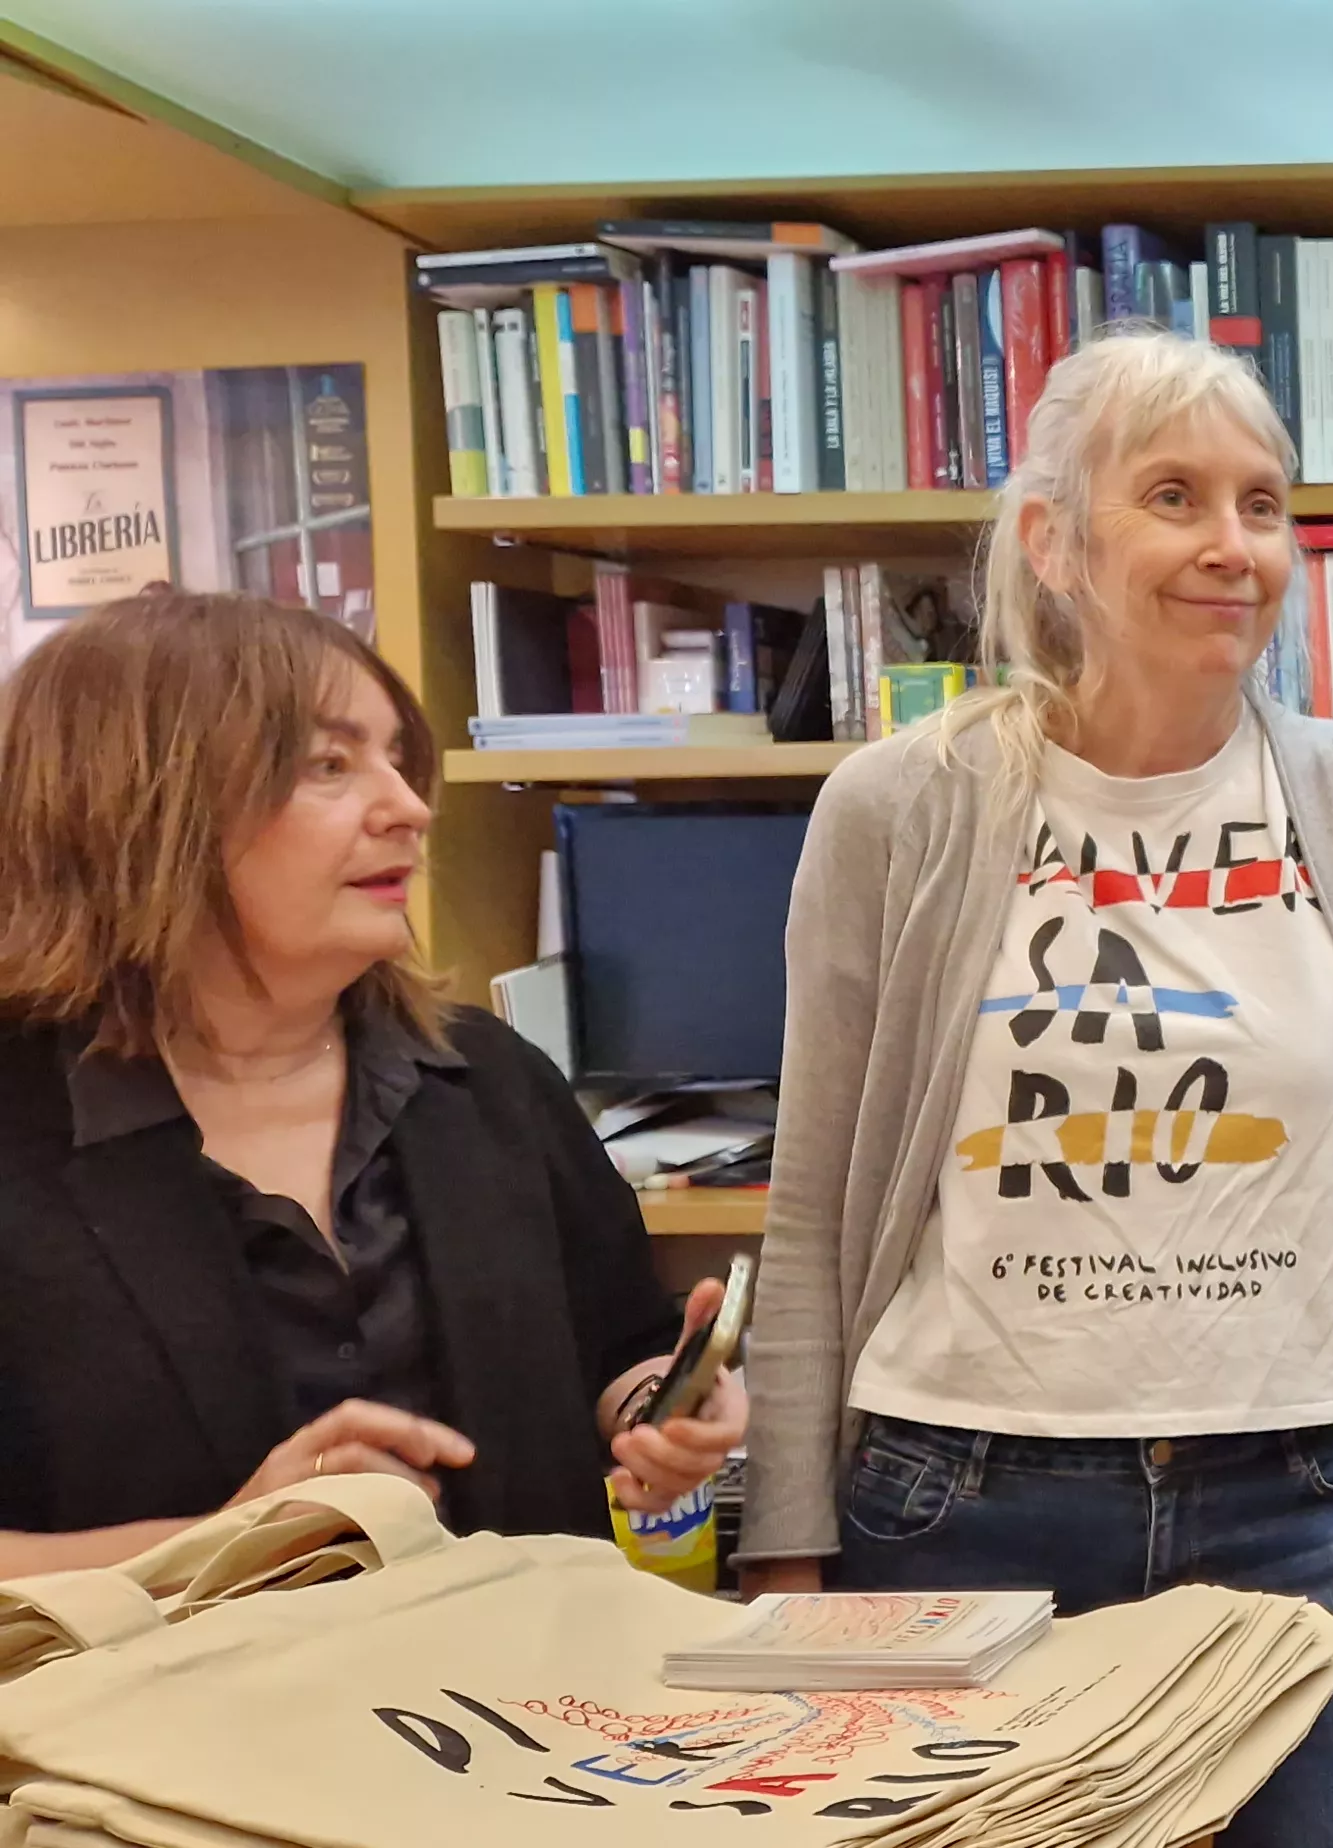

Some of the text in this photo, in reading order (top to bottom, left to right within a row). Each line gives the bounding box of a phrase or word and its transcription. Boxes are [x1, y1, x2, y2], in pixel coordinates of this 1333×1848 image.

[34, 501, 162, 564] LIBRERÍA
[1008, 916, 1167, 1052] SA
[998, 1056, 1230, 1202] RIO
[1024, 1254, 1157, 1278] FESTIVAL
[1176, 1248, 1298, 1275] INCLUSIVO
[1038, 1279, 1263, 1302] DE CREATIVIDAD
